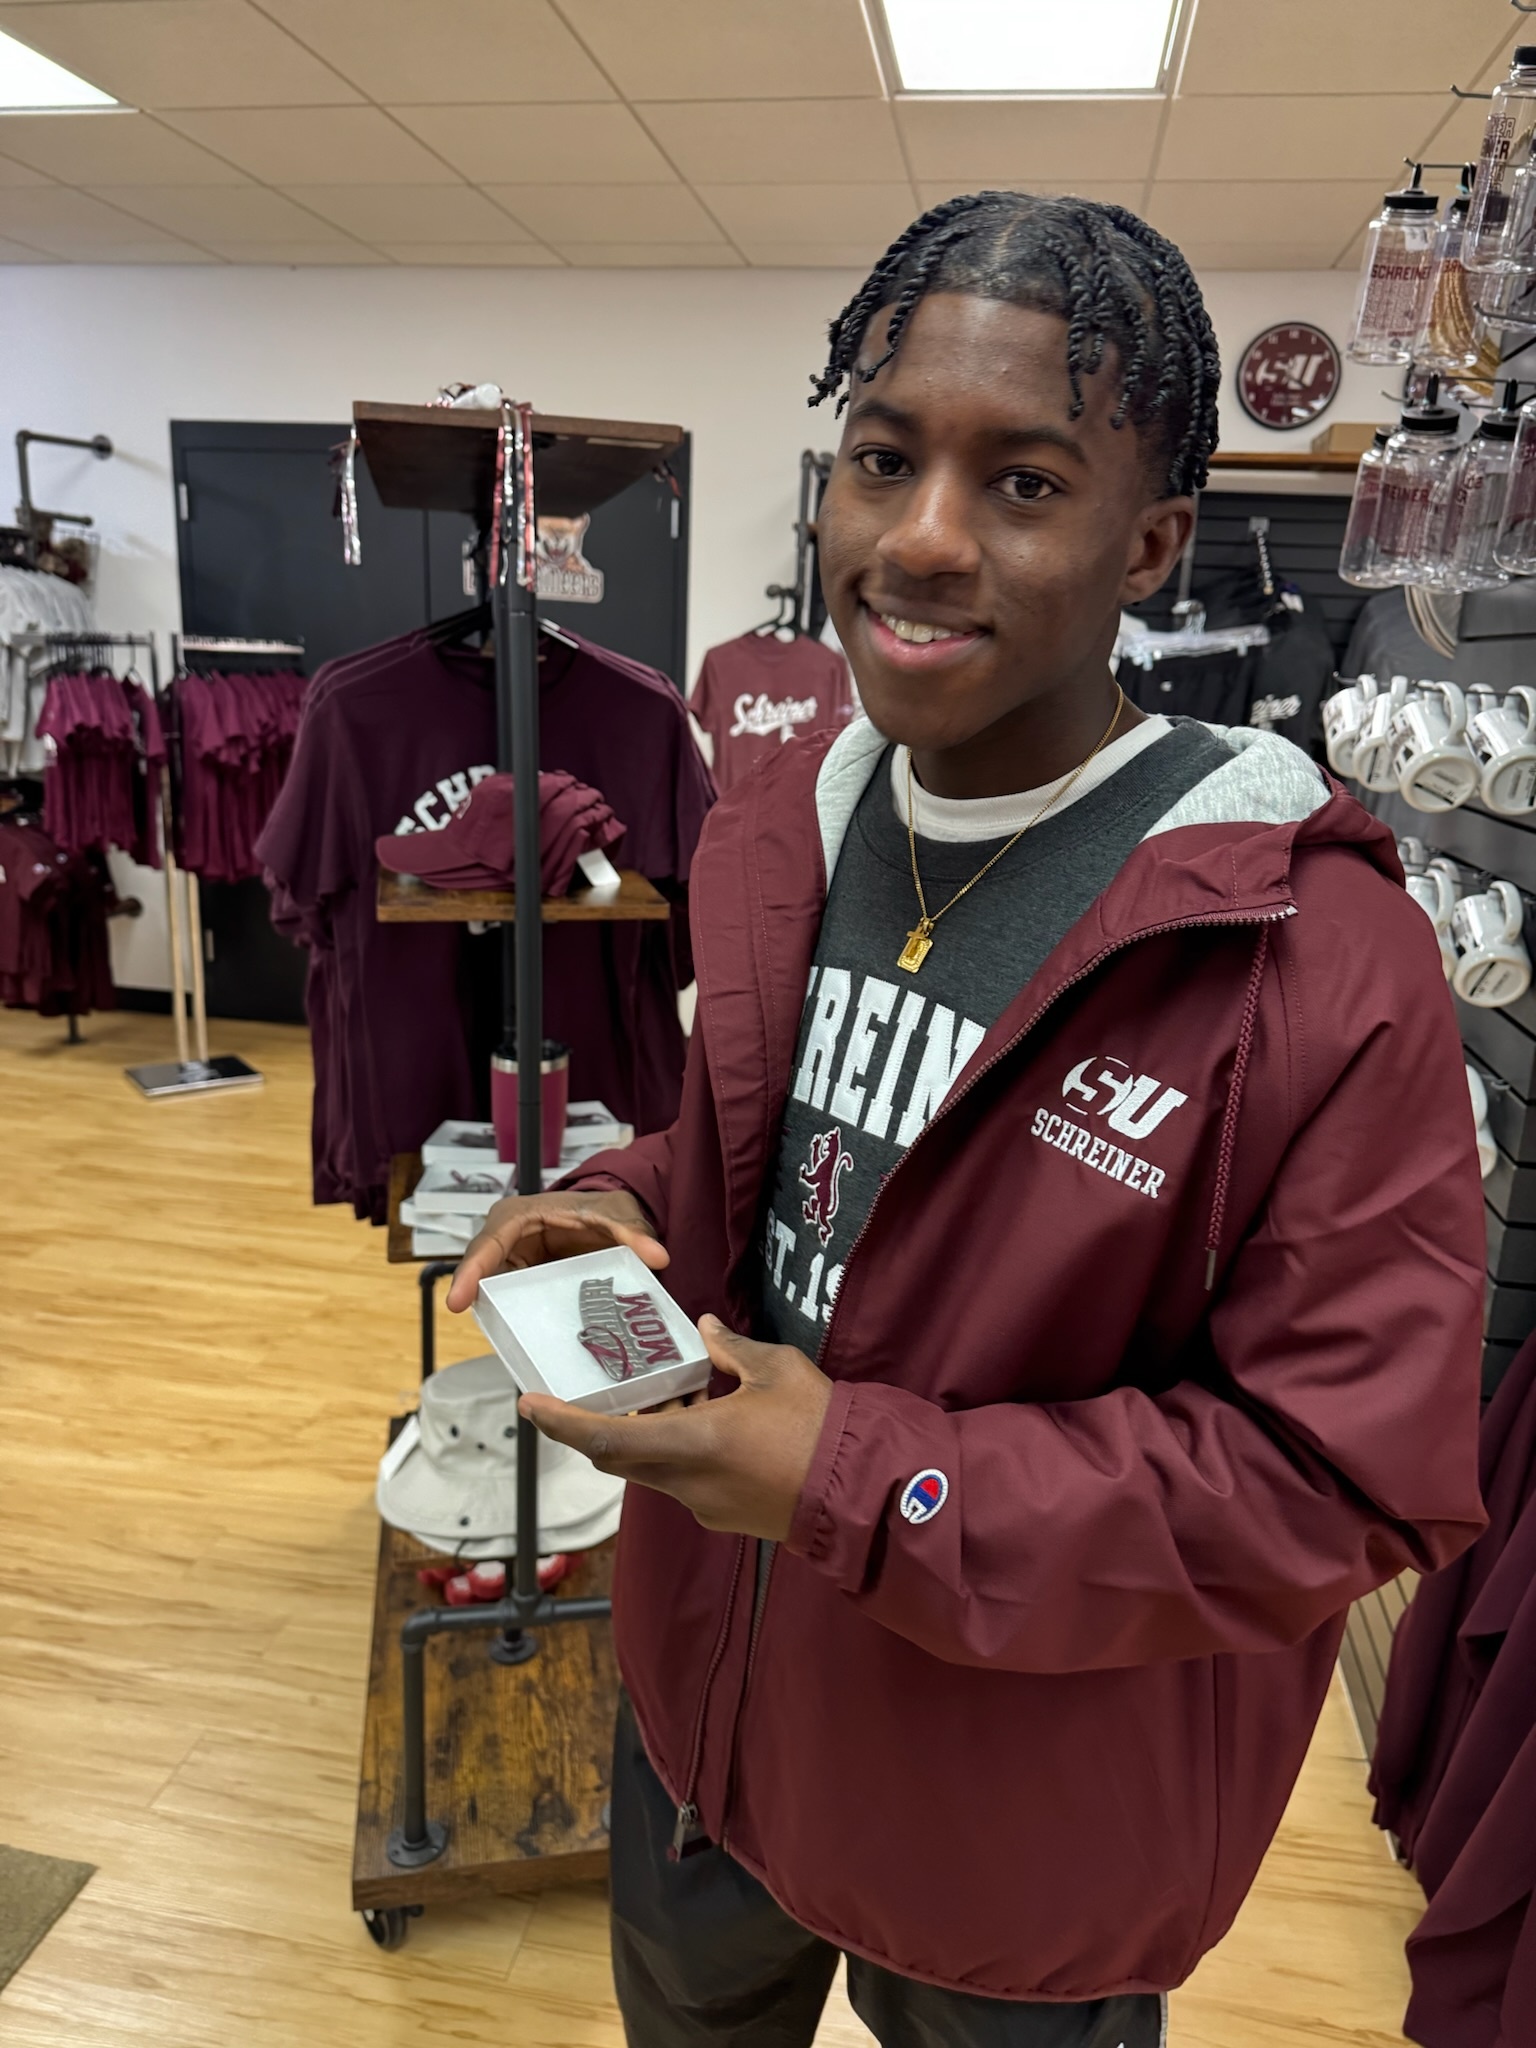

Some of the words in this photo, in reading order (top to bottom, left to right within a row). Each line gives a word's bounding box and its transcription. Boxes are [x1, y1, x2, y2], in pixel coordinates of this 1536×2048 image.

[792, 965, 987, 1148] REIN
[1061, 1055, 1189, 1140] SU
[1031, 1107, 1166, 1199] SCHREINER
[614, 1291, 682, 1366] MOM
